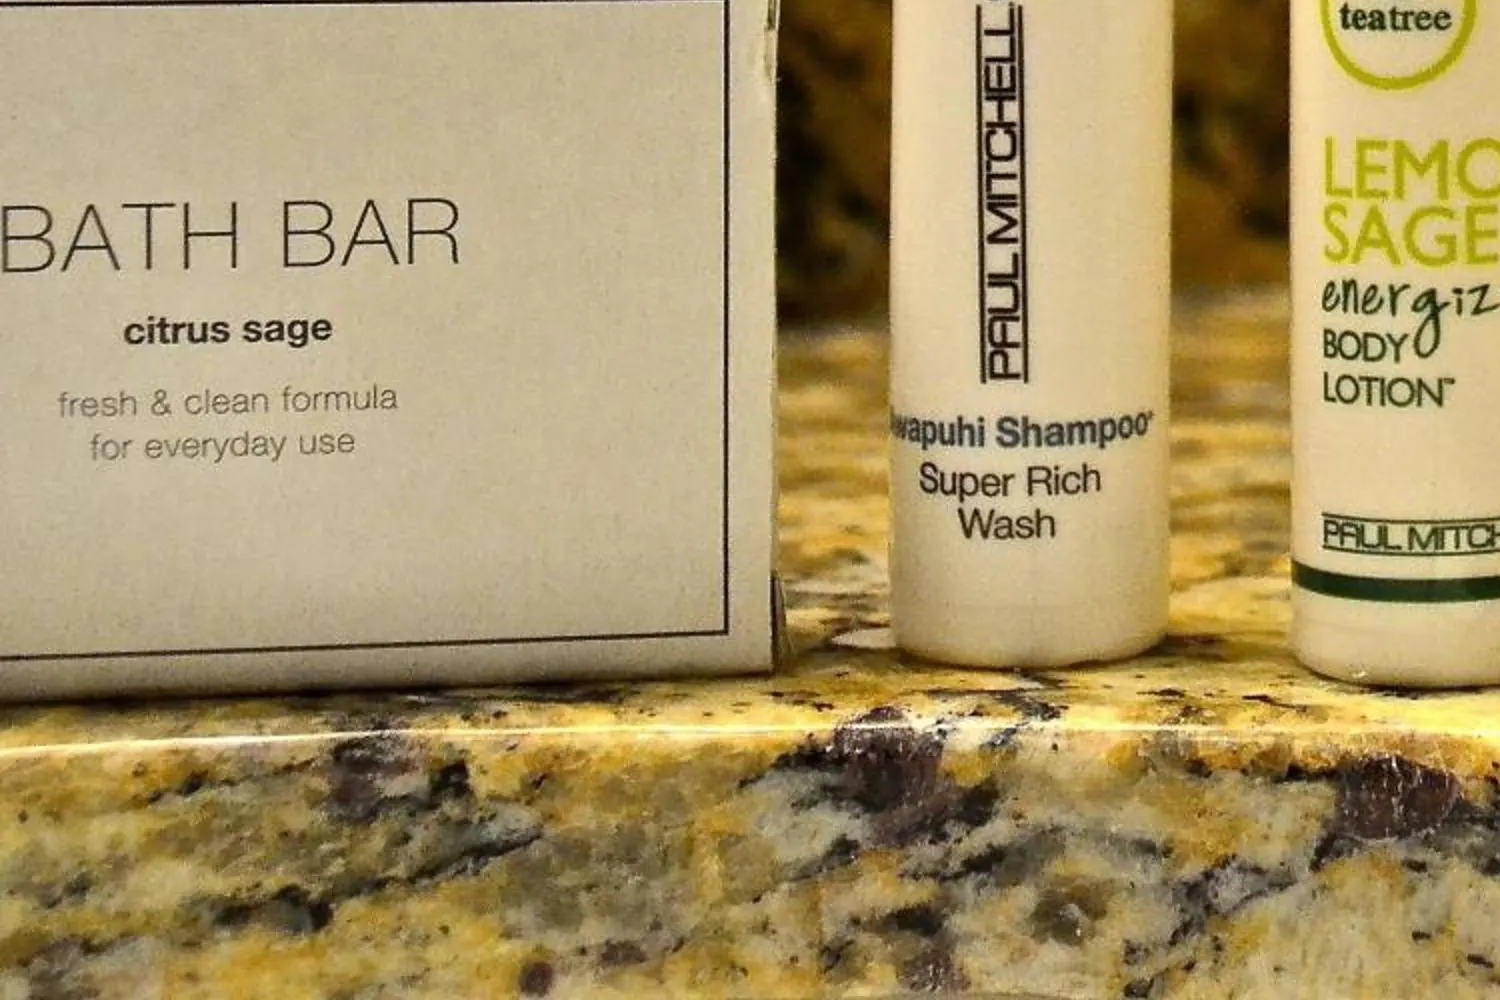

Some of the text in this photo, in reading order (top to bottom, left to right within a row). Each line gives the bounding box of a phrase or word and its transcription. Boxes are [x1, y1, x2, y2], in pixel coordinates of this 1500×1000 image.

[983, 5, 1020, 246] MITCHELL
[0, 197, 461, 273] BATH BAR
[1322, 202, 1500, 267] SAGE
[122, 314, 334, 350] citrus sage
[987, 252, 1022, 382] PAUL
[1322, 327, 1408, 364] BODY
[57, 383, 400, 419] fresh & clean formula
[89, 430, 357, 465] for everyday use
[890, 405, 986, 451] wapuhi
[918, 461, 1102, 503] Super Rich
[957, 507, 1057, 541] Wash
[1322, 518, 1403, 551] PAUL
